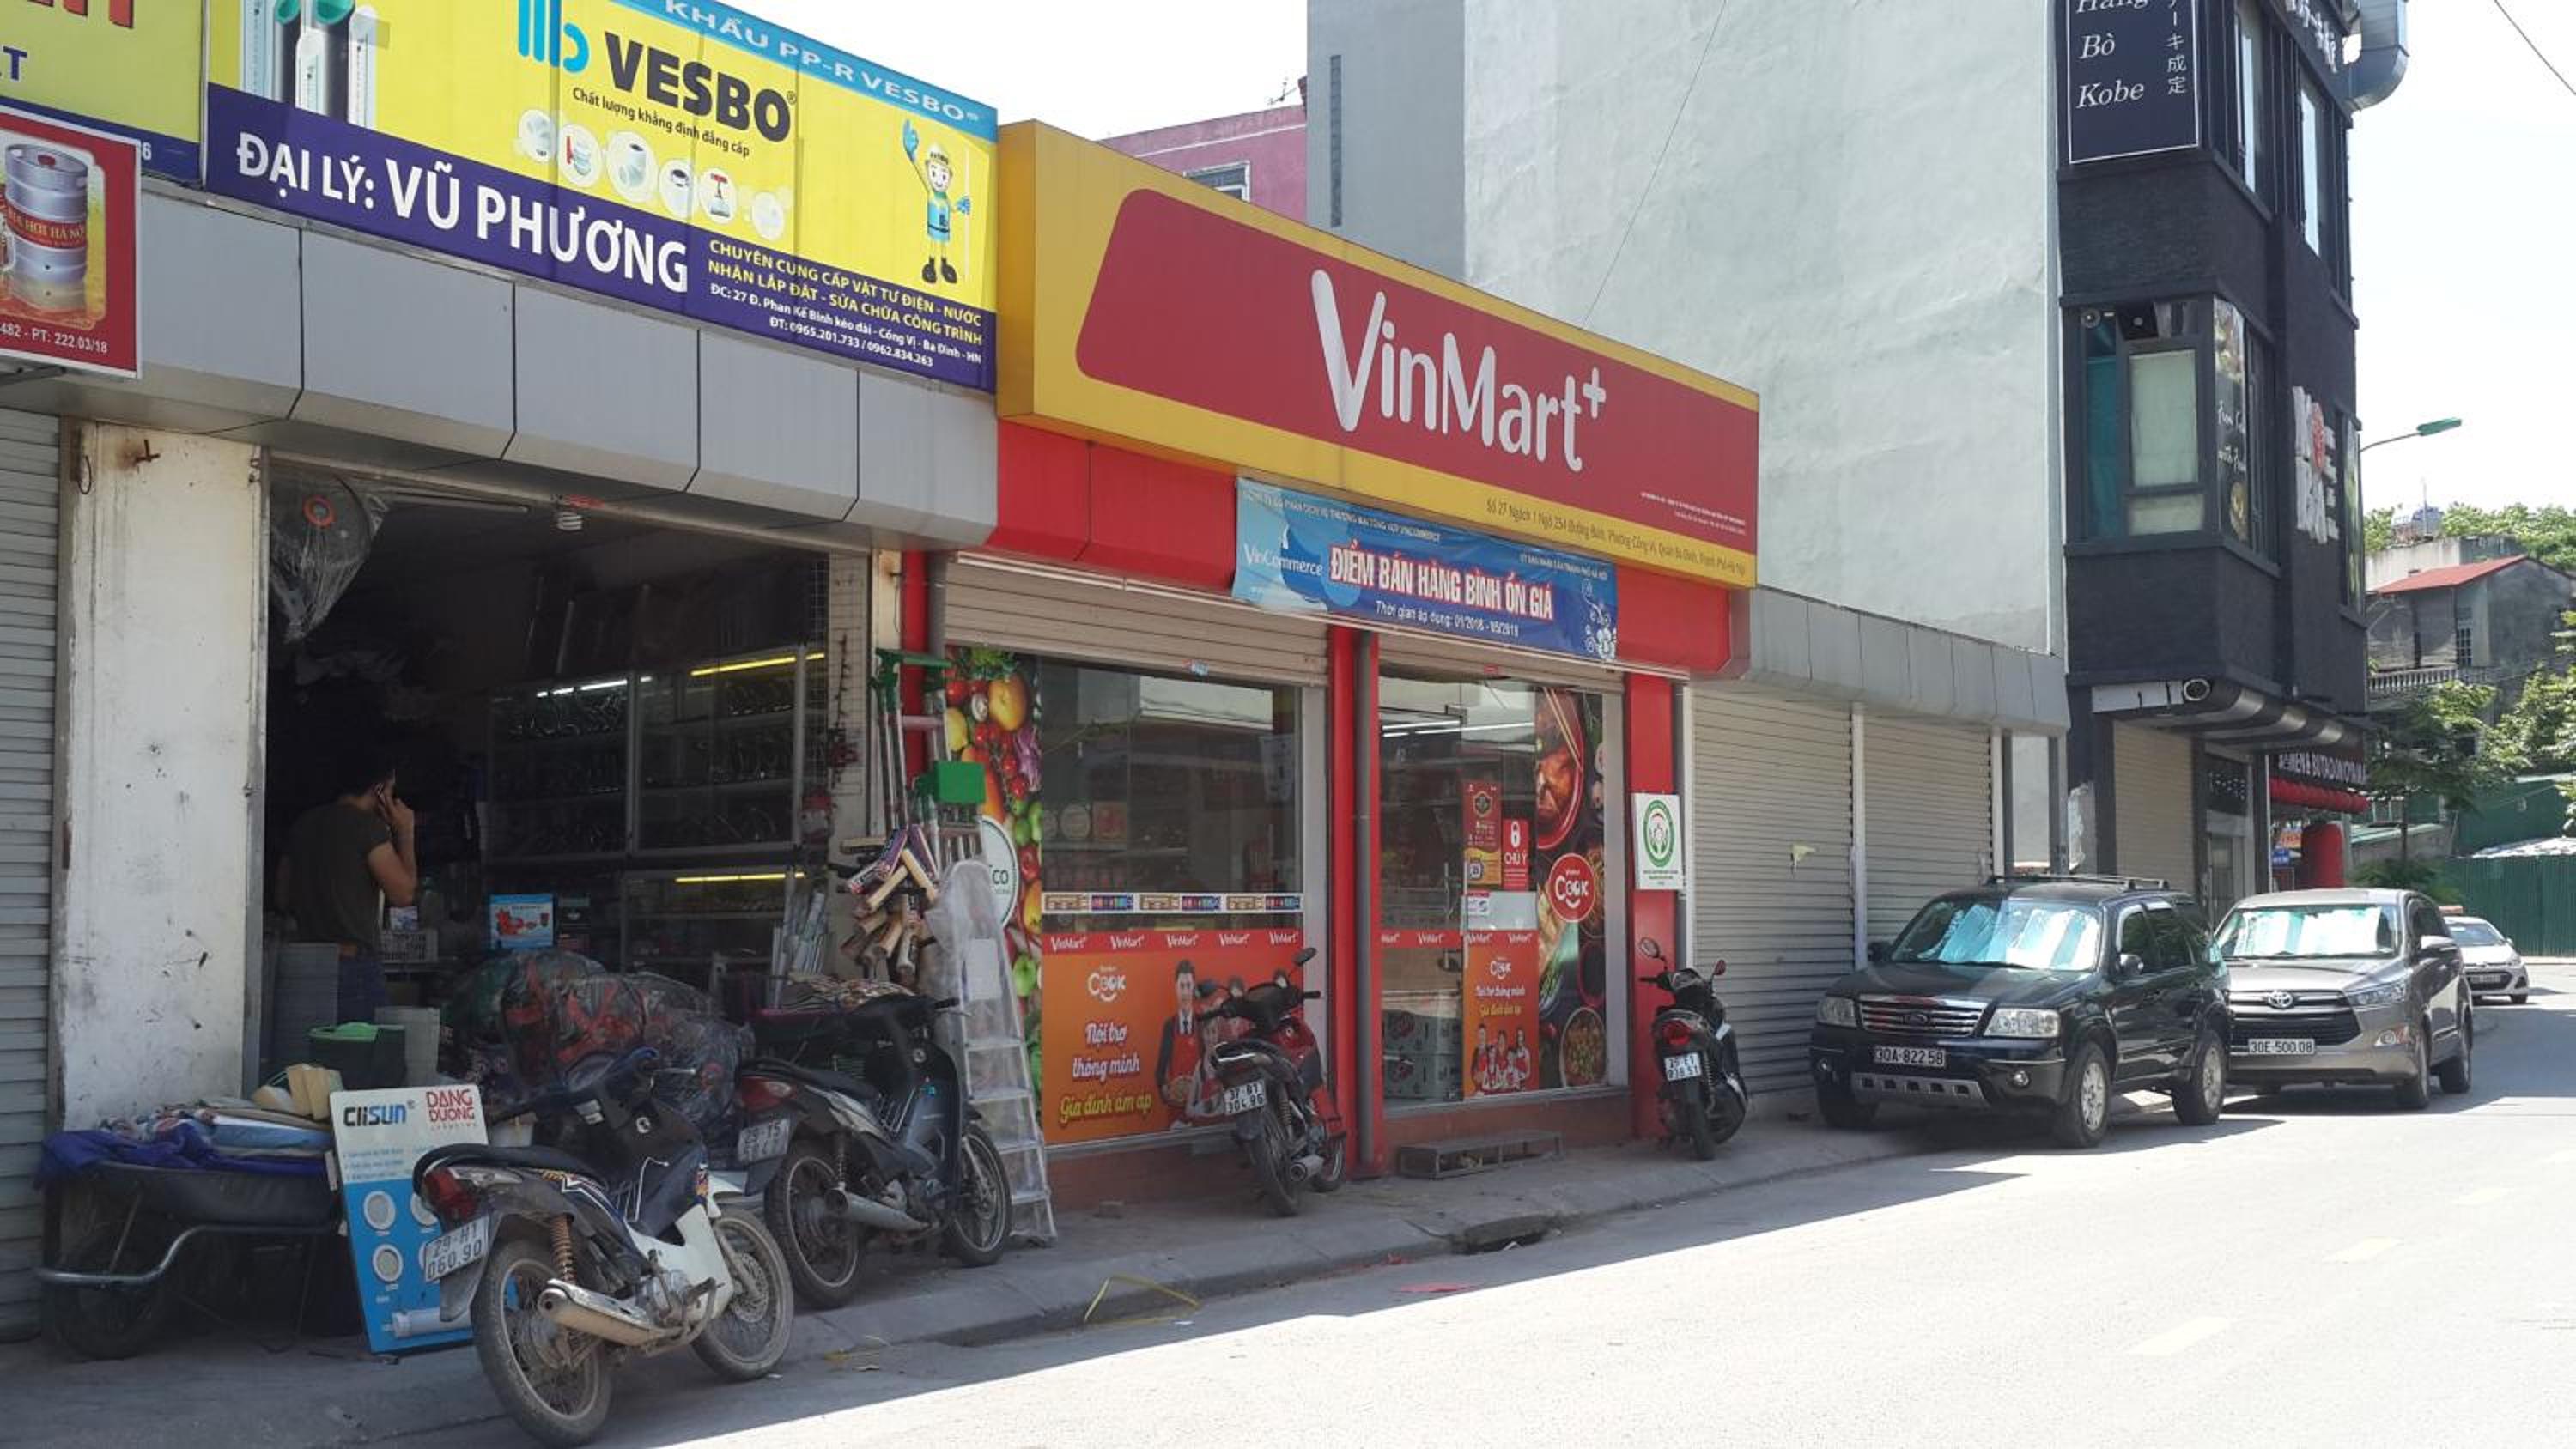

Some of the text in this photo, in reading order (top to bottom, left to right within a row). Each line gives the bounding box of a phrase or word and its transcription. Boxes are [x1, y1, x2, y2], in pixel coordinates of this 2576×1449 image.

[780, 41, 854, 82] PP-R
[2079, 32, 2115, 59] Bò
[572, 87, 599, 107] Chất
[2076, 79, 2145, 109] Kobe
[236, 132, 689, 294] ĐẠI LÝ: VŨ PHƯƠNG
[709, 239, 773, 270] CHUYÊN
[776, 259, 818, 282] CUNG
[822, 267, 849, 288] CẤP
[852, 280, 878, 300] VẬT
[879, 287, 899, 303] TƯ
[902, 294, 934, 316] ĐIỆN
[943, 304, 981, 327] NƯỚC
[708, 260, 755, 285] NHẬN
[902, 312, 942, 336] CÔNG
[943, 323, 982, 347] TRÌNH
[710, 282, 731, 300] ĐC:
[732, 289, 746, 304] 27
[763, 299, 791, 317] Phan
[923, 340, 936, 352] Ba
[32, 328, 52, 343] PT:
[769, 315, 788, 331] ĐT:
[1244, 542, 1323, 577] VinCommerce
[1331, 539, 1374, 588] ĐIỂM
[1378, 550, 1413, 595] BÁN
[1417, 561, 1461, 602] HÀNG
[1465, 567, 1501, 610] BÌNH
[1529, 584, 1553, 621] GIÁ
[1109, 1053, 1140, 1074] minh
[1060, 1095, 1083, 1123] Gia
